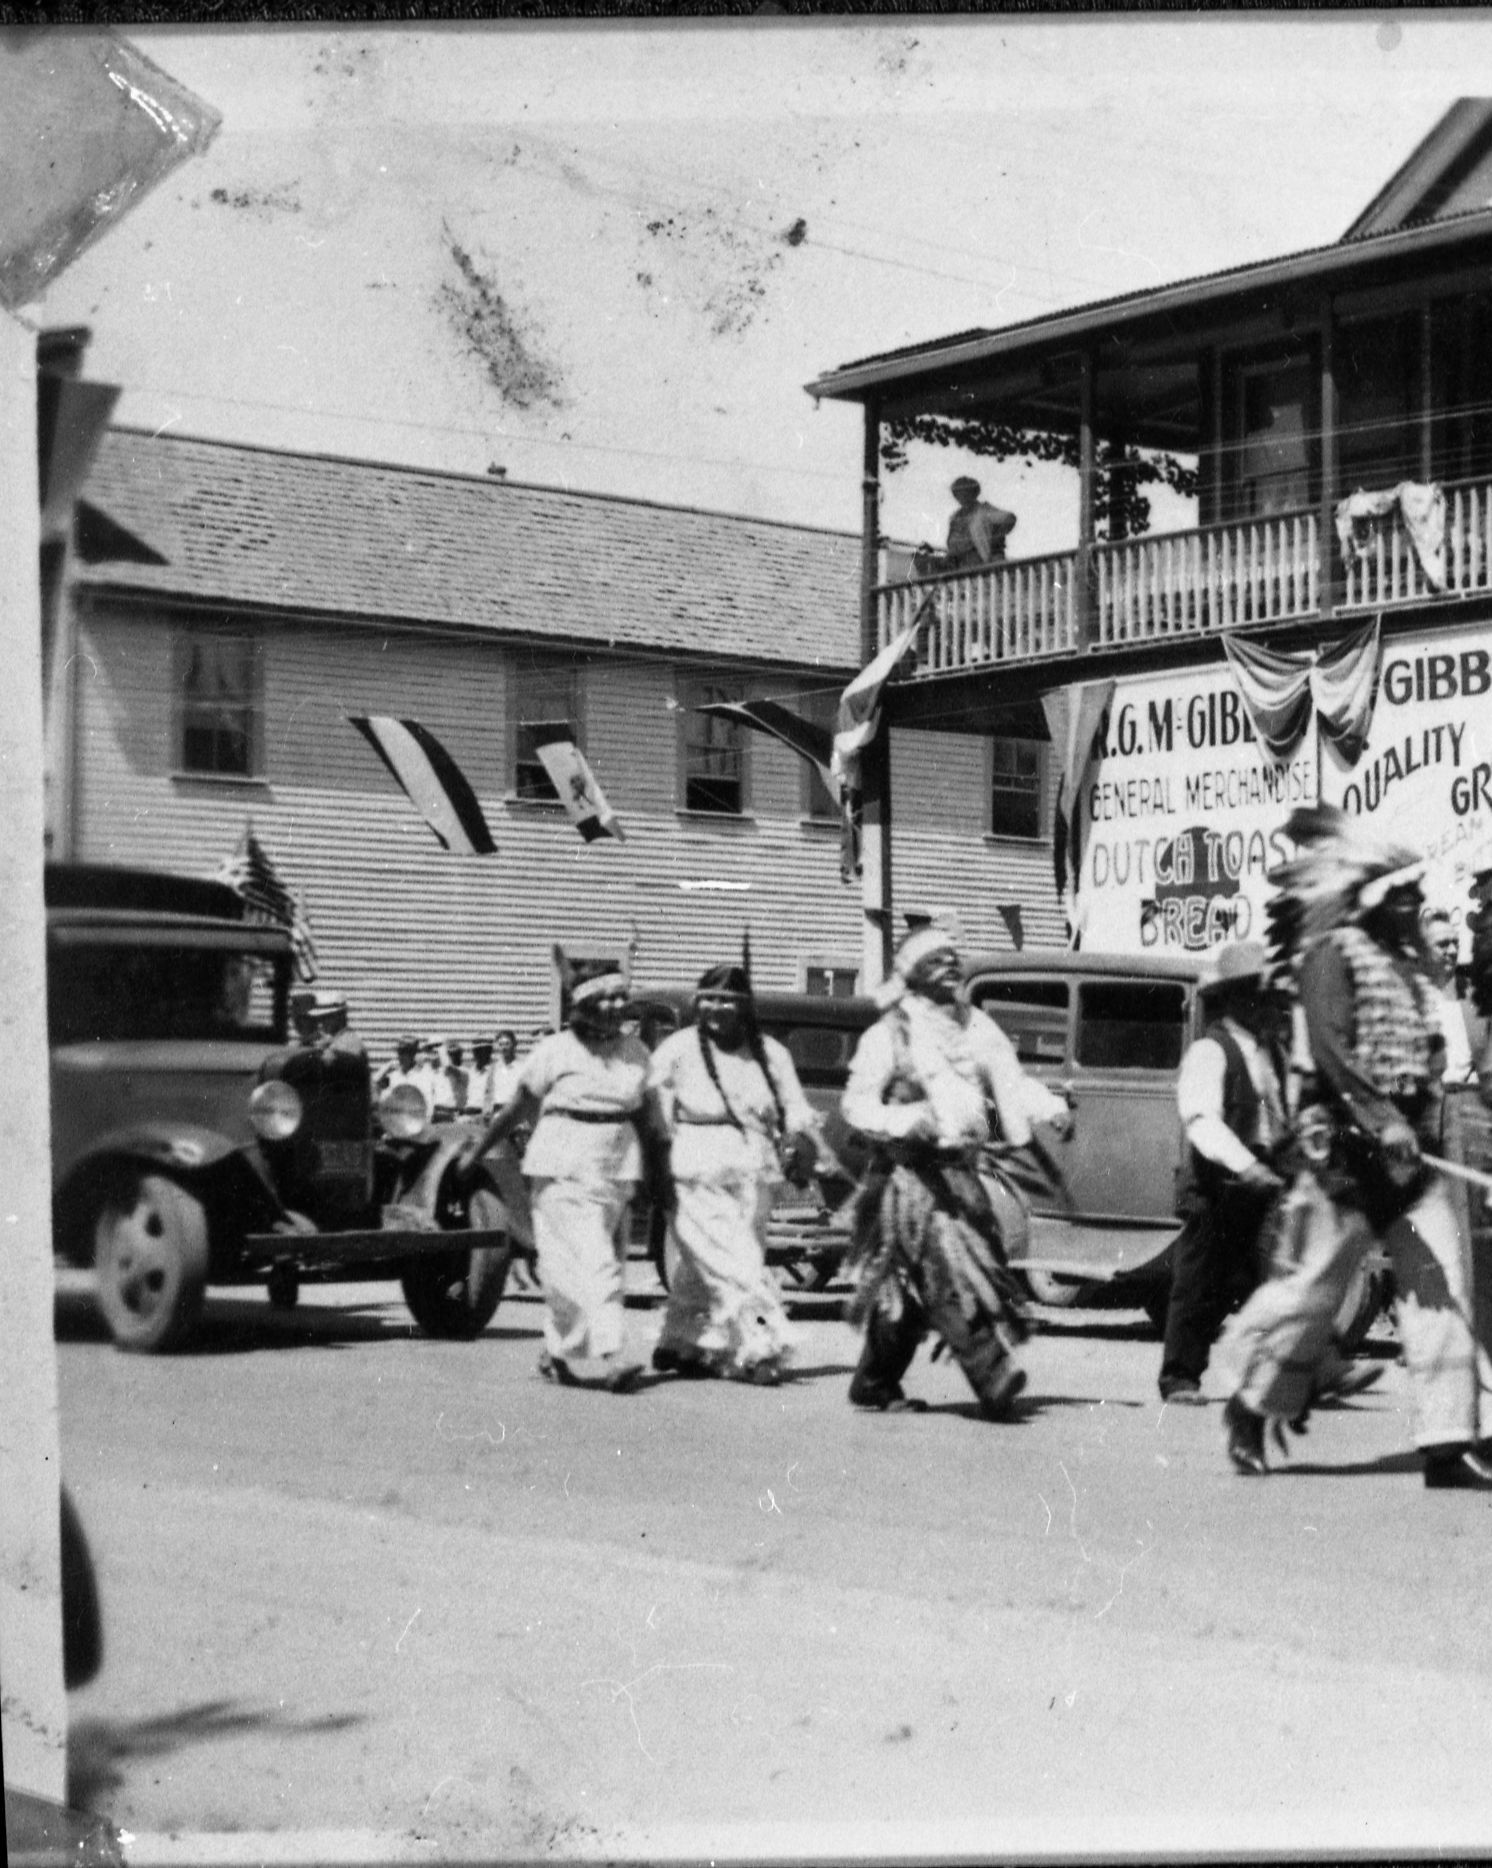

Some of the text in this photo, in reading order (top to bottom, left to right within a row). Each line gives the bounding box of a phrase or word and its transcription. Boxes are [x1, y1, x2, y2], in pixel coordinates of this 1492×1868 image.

[1090, 761, 1312, 822] GENERAL MERCHANDISE
[1093, 829, 1288, 888] DUTCH TOAS
[1140, 894, 1251, 947] BREAD
